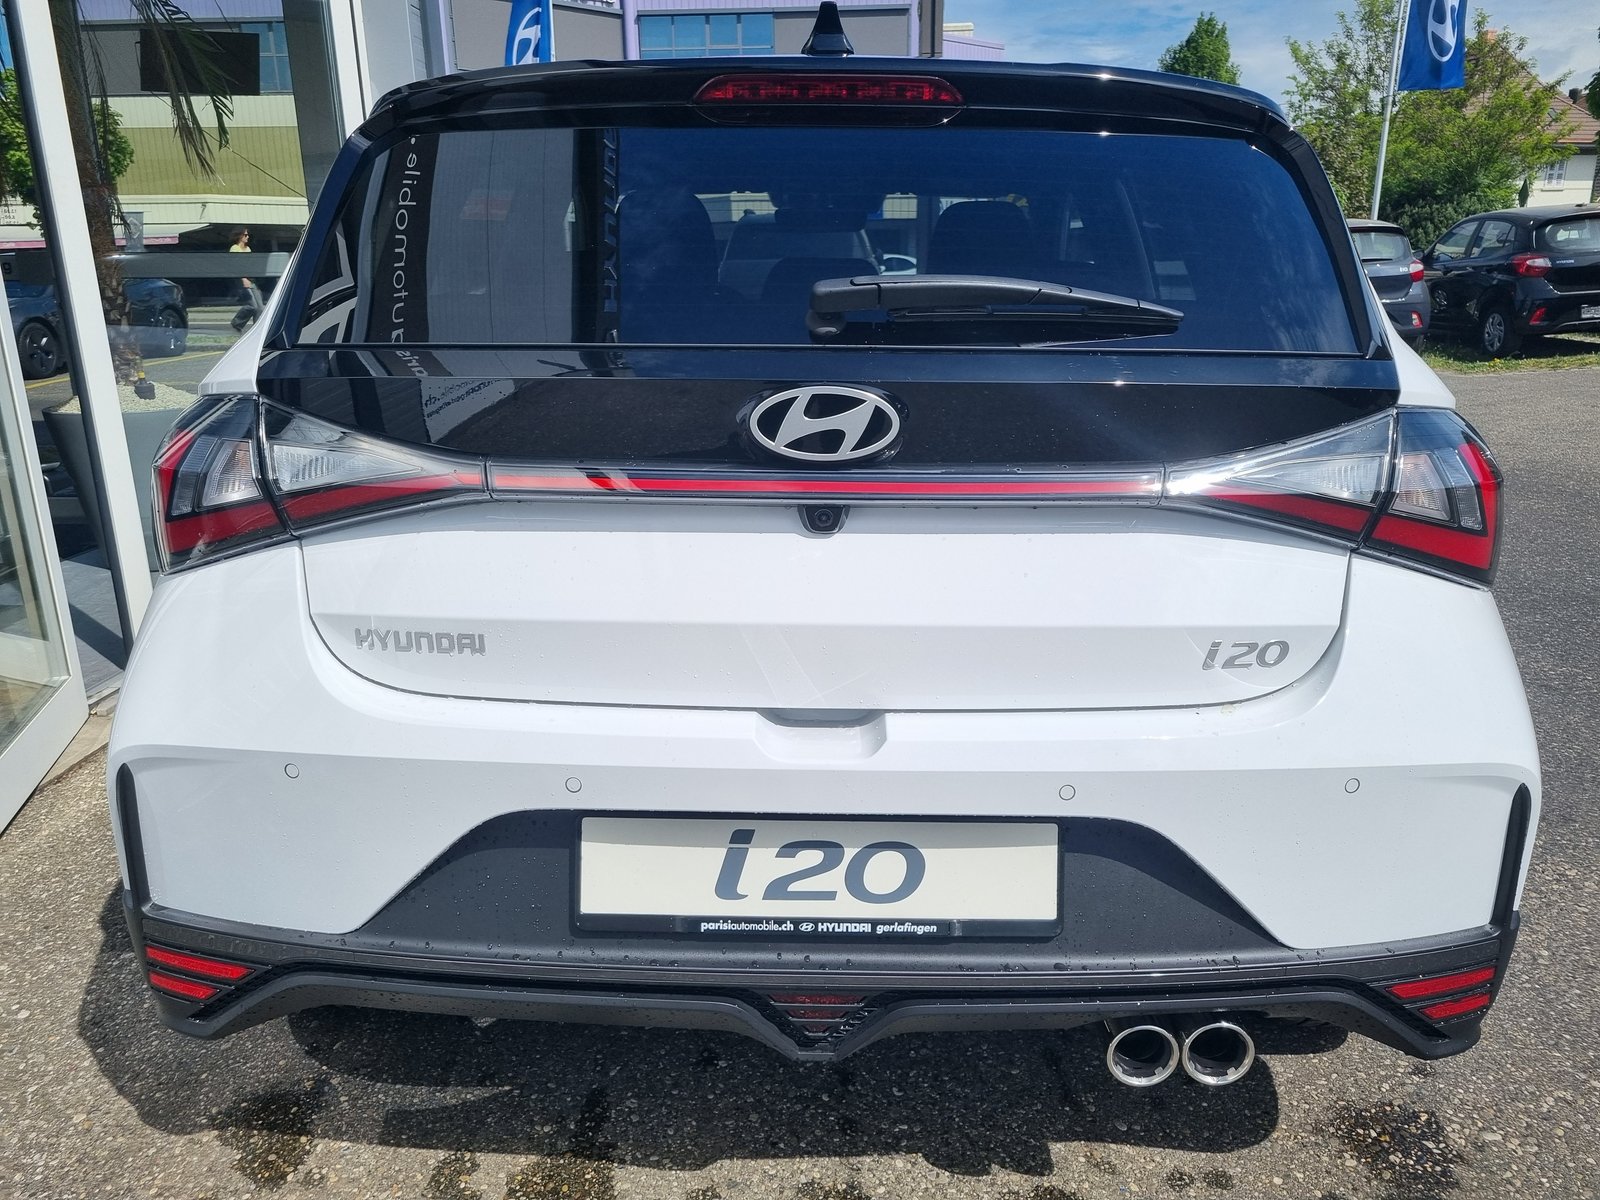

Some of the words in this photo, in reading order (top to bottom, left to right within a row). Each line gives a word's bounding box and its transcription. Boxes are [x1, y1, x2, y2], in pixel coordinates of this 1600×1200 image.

[354, 628, 487, 656] HYUNDAI
[1202, 640, 1290, 670] i20
[714, 829, 926, 904] i20
[700, 919, 794, 933] parisiautomobile.ch
[818, 922, 871, 932] HYUNDAI
[876, 921, 938, 935] gerlafingen
